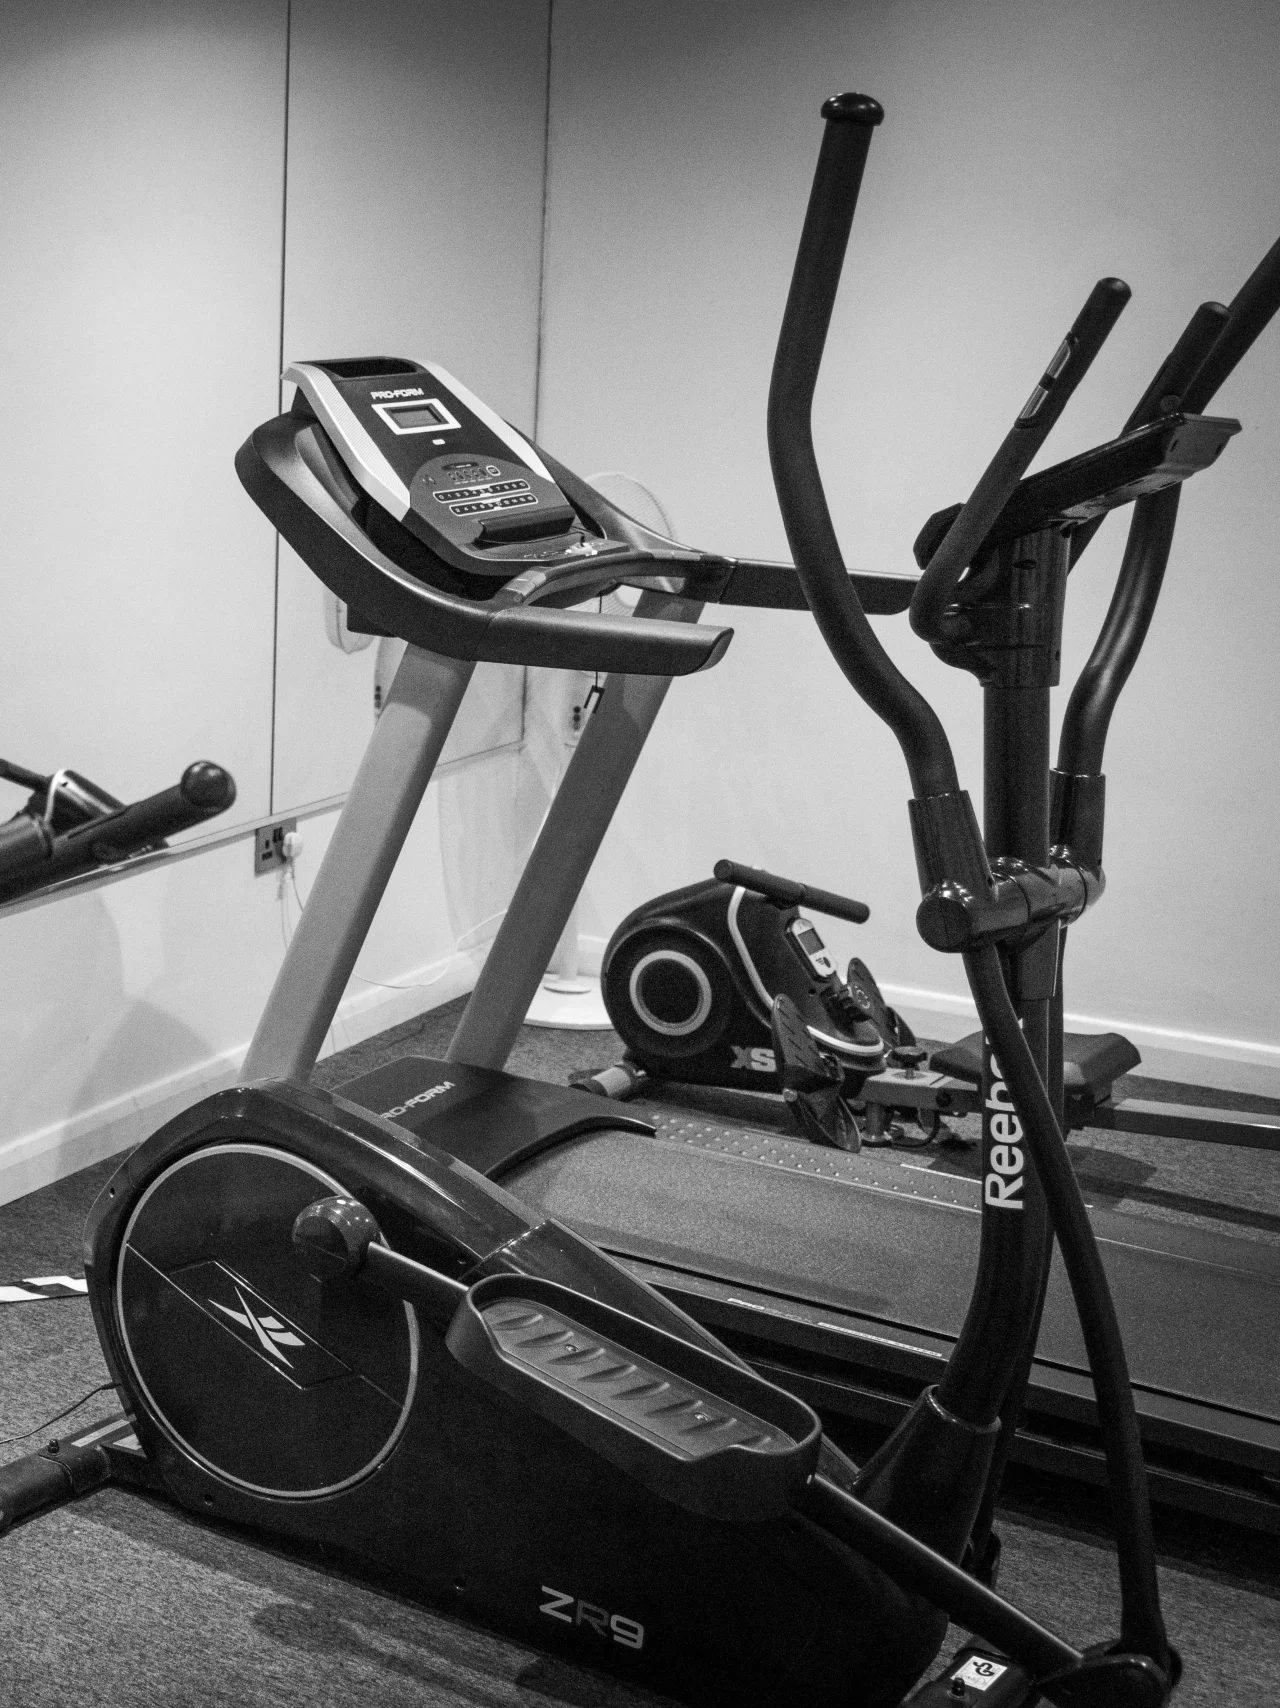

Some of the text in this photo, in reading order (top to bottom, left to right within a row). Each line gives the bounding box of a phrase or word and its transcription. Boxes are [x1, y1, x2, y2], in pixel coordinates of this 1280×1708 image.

[370, 388, 425, 400] PRO-FORM
[730, 1045, 777, 1073] XS
[379, 1081, 456, 1119] RO-FORM
[985, 1018, 1024, 1209] Reeb
[540, 1585, 644, 1650] ZR9
